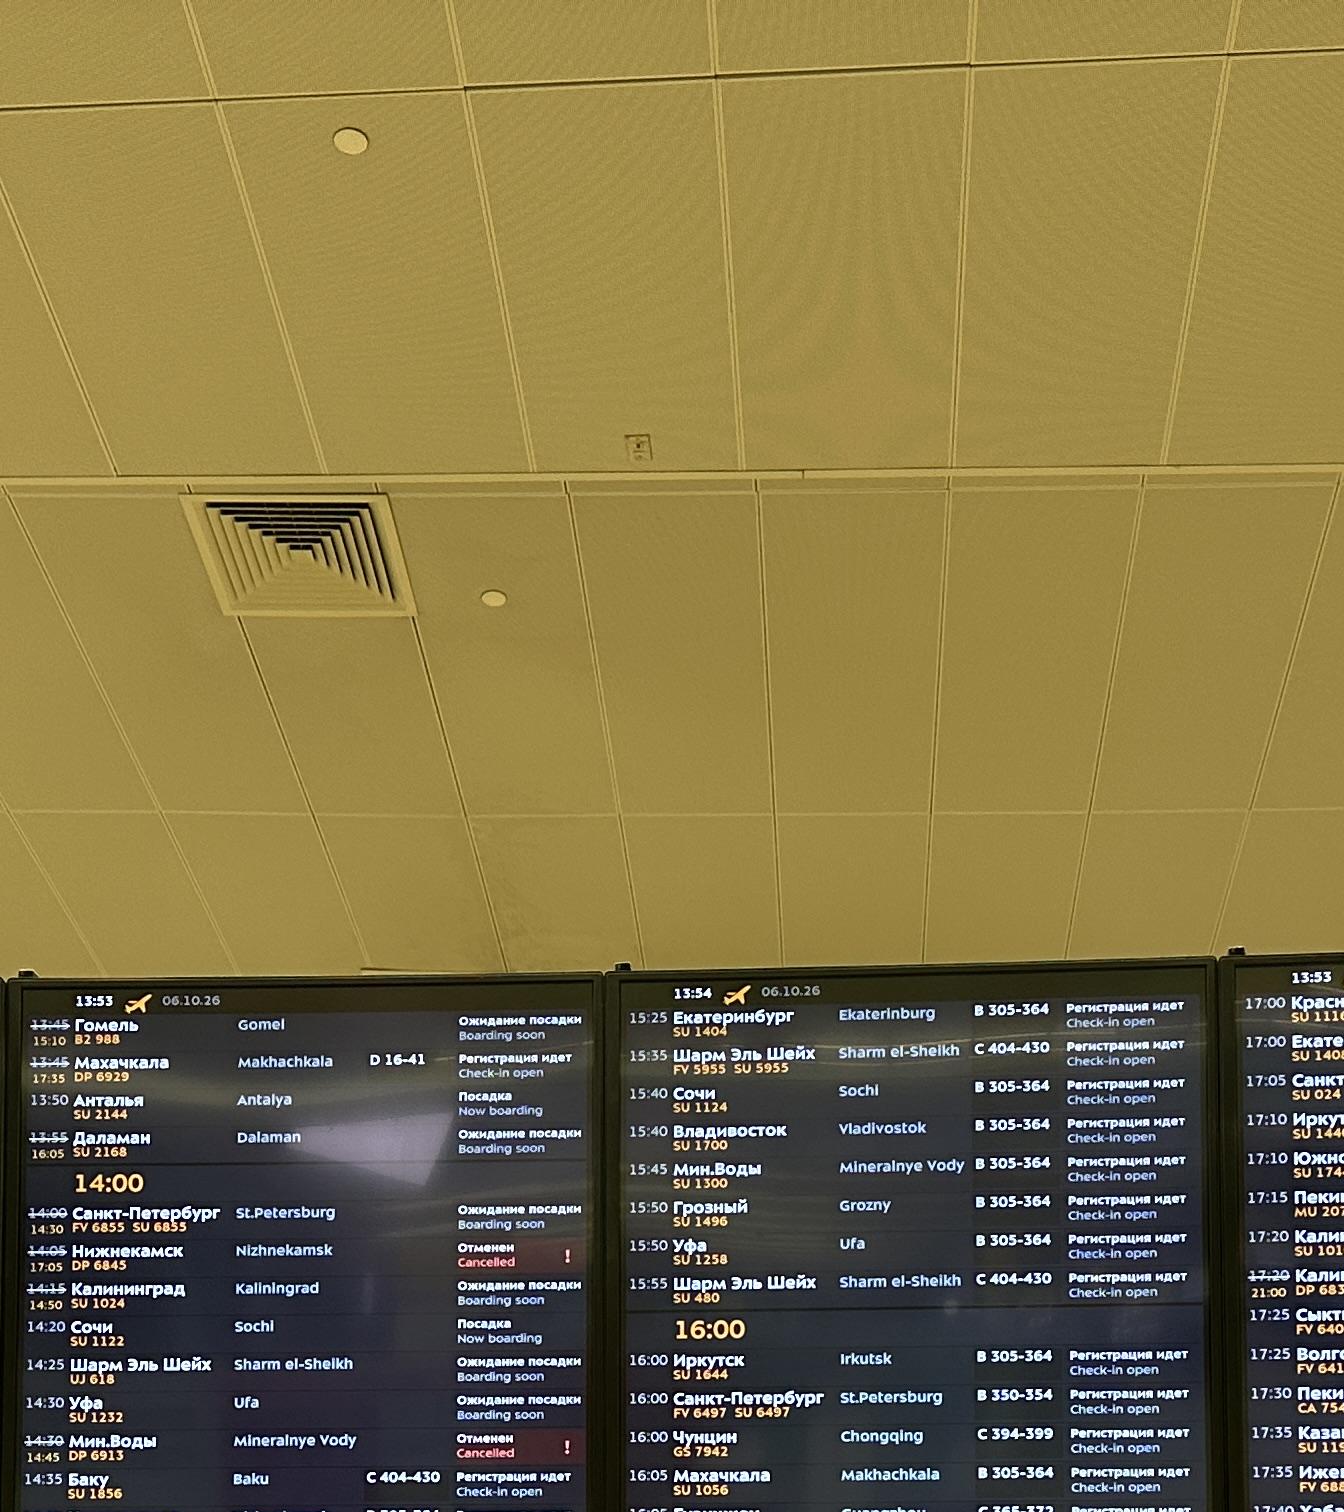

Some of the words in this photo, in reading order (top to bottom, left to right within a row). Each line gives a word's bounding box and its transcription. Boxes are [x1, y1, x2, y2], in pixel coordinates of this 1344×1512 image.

[840, 1008, 935, 1021] Ekaterinburg
[75, 1019, 138, 1031] Гомель
[238, 1018, 284, 1030] Gomel
[238, 1056, 333, 1067] Makhachkala
[839, 1122, 926, 1134] Vladivostok
[76, 1174, 144, 1193] 14:00
[236, 1206, 335, 1220] St.Petersburg
[458, 1257, 515, 1267] Cancelled
[976, 1274, 986, 1285] C
[990, 1273, 1052, 1284] 404-430
[677, 1320, 745, 1339] 16:00
[235, 1359, 280, 1370] Sharm
[285, 1358, 353, 1370] el-Sheikh
[1297, 1403, 1317, 1413] CA
[673, 1431, 737, 1446] Чунцин
[841, 1429, 923, 1444] Chongqing
